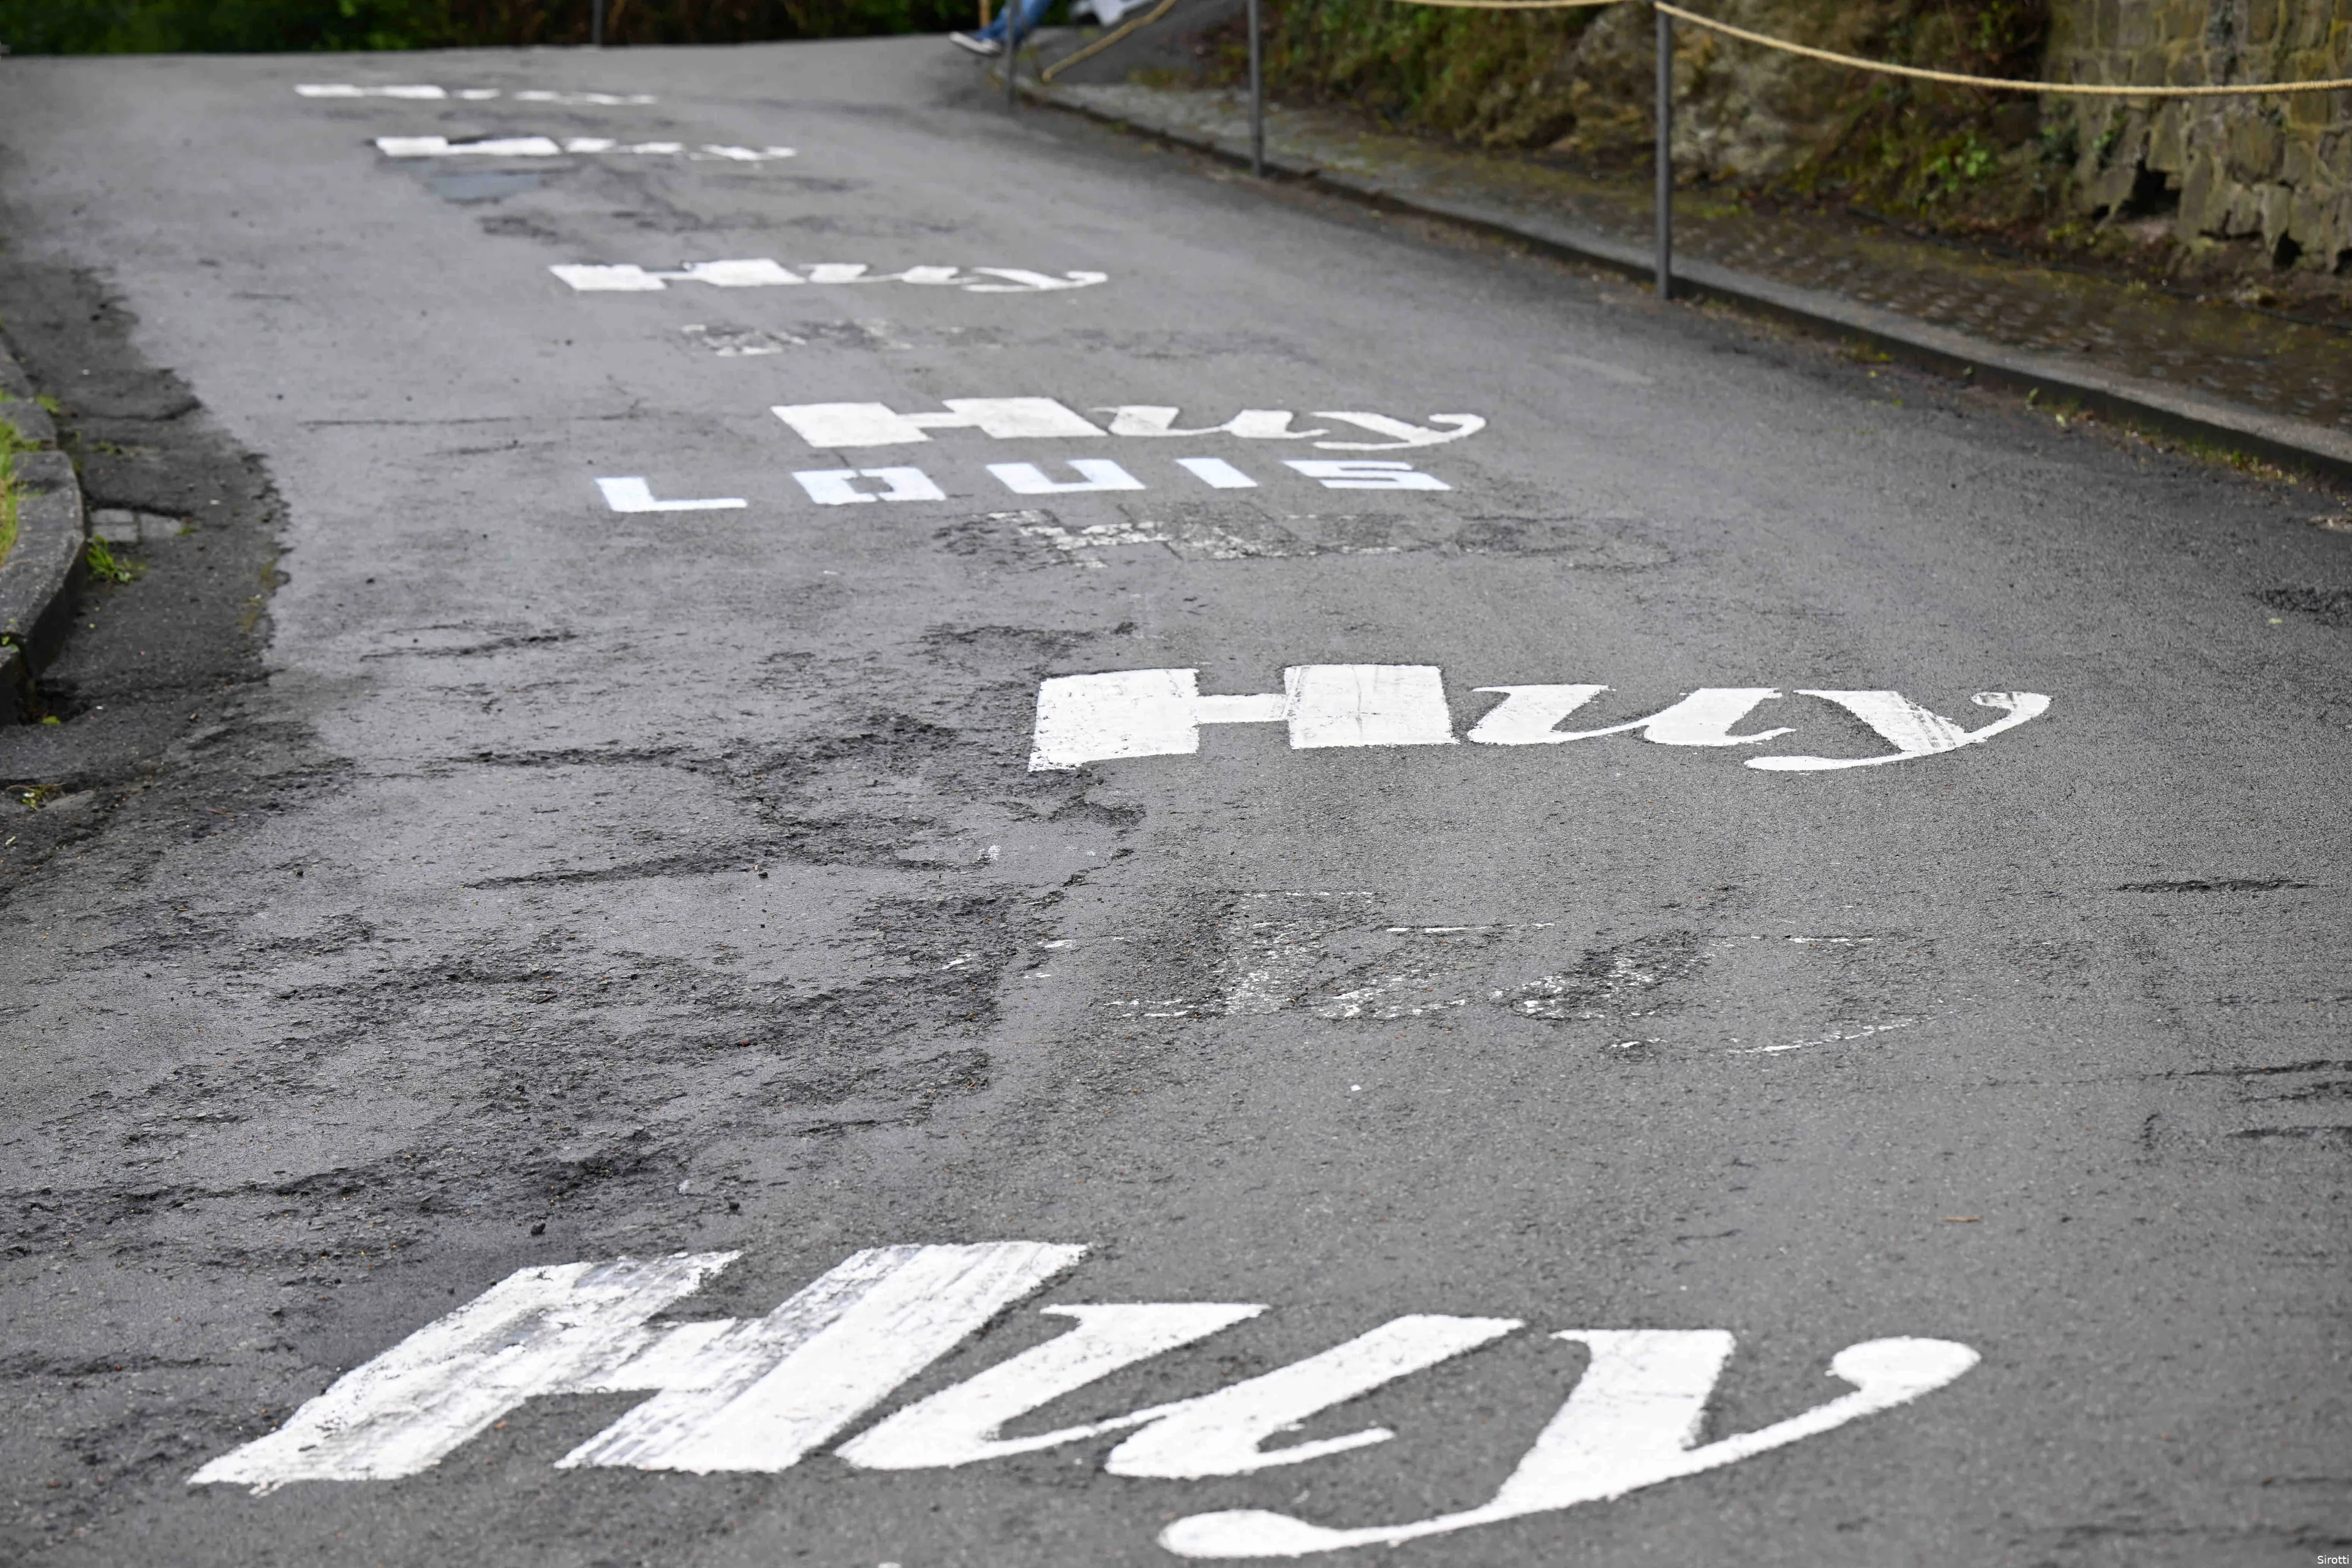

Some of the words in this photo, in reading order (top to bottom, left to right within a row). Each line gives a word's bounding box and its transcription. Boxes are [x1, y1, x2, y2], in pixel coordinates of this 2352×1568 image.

[549, 258, 1109, 293] Huy
[771, 396, 1487, 451] Huy
[596, 457, 1452, 513] LOUIS
[1028, 663, 2051, 773] Huy
[187, 1240, 1981, 1559] Huy
